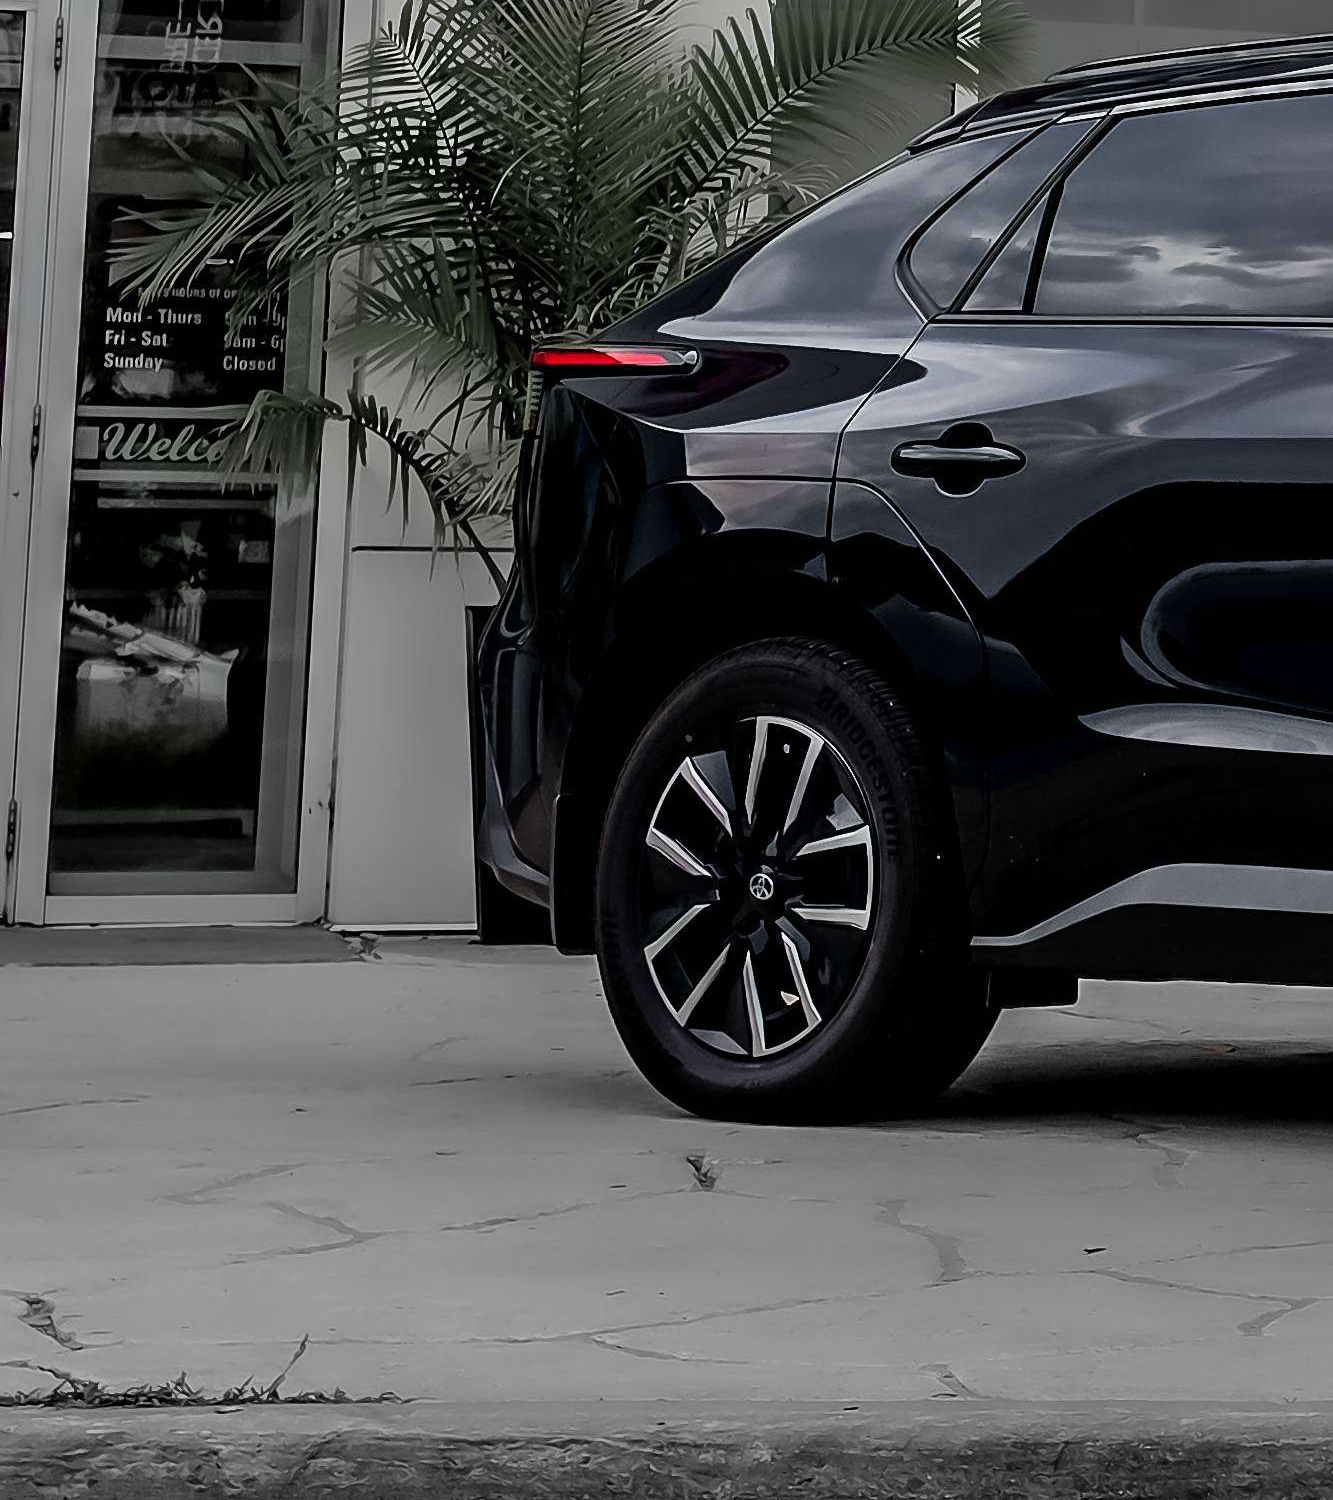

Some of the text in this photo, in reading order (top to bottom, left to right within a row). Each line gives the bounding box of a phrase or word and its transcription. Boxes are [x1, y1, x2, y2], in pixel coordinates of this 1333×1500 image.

[105, 306, 142, 324] Mon
[157, 308, 203, 325] Thurs
[104, 329, 126, 345] Fri
[141, 329, 168, 347] Sat
[103, 351, 163, 373] Sunday
[222, 354, 276, 371] Closed
